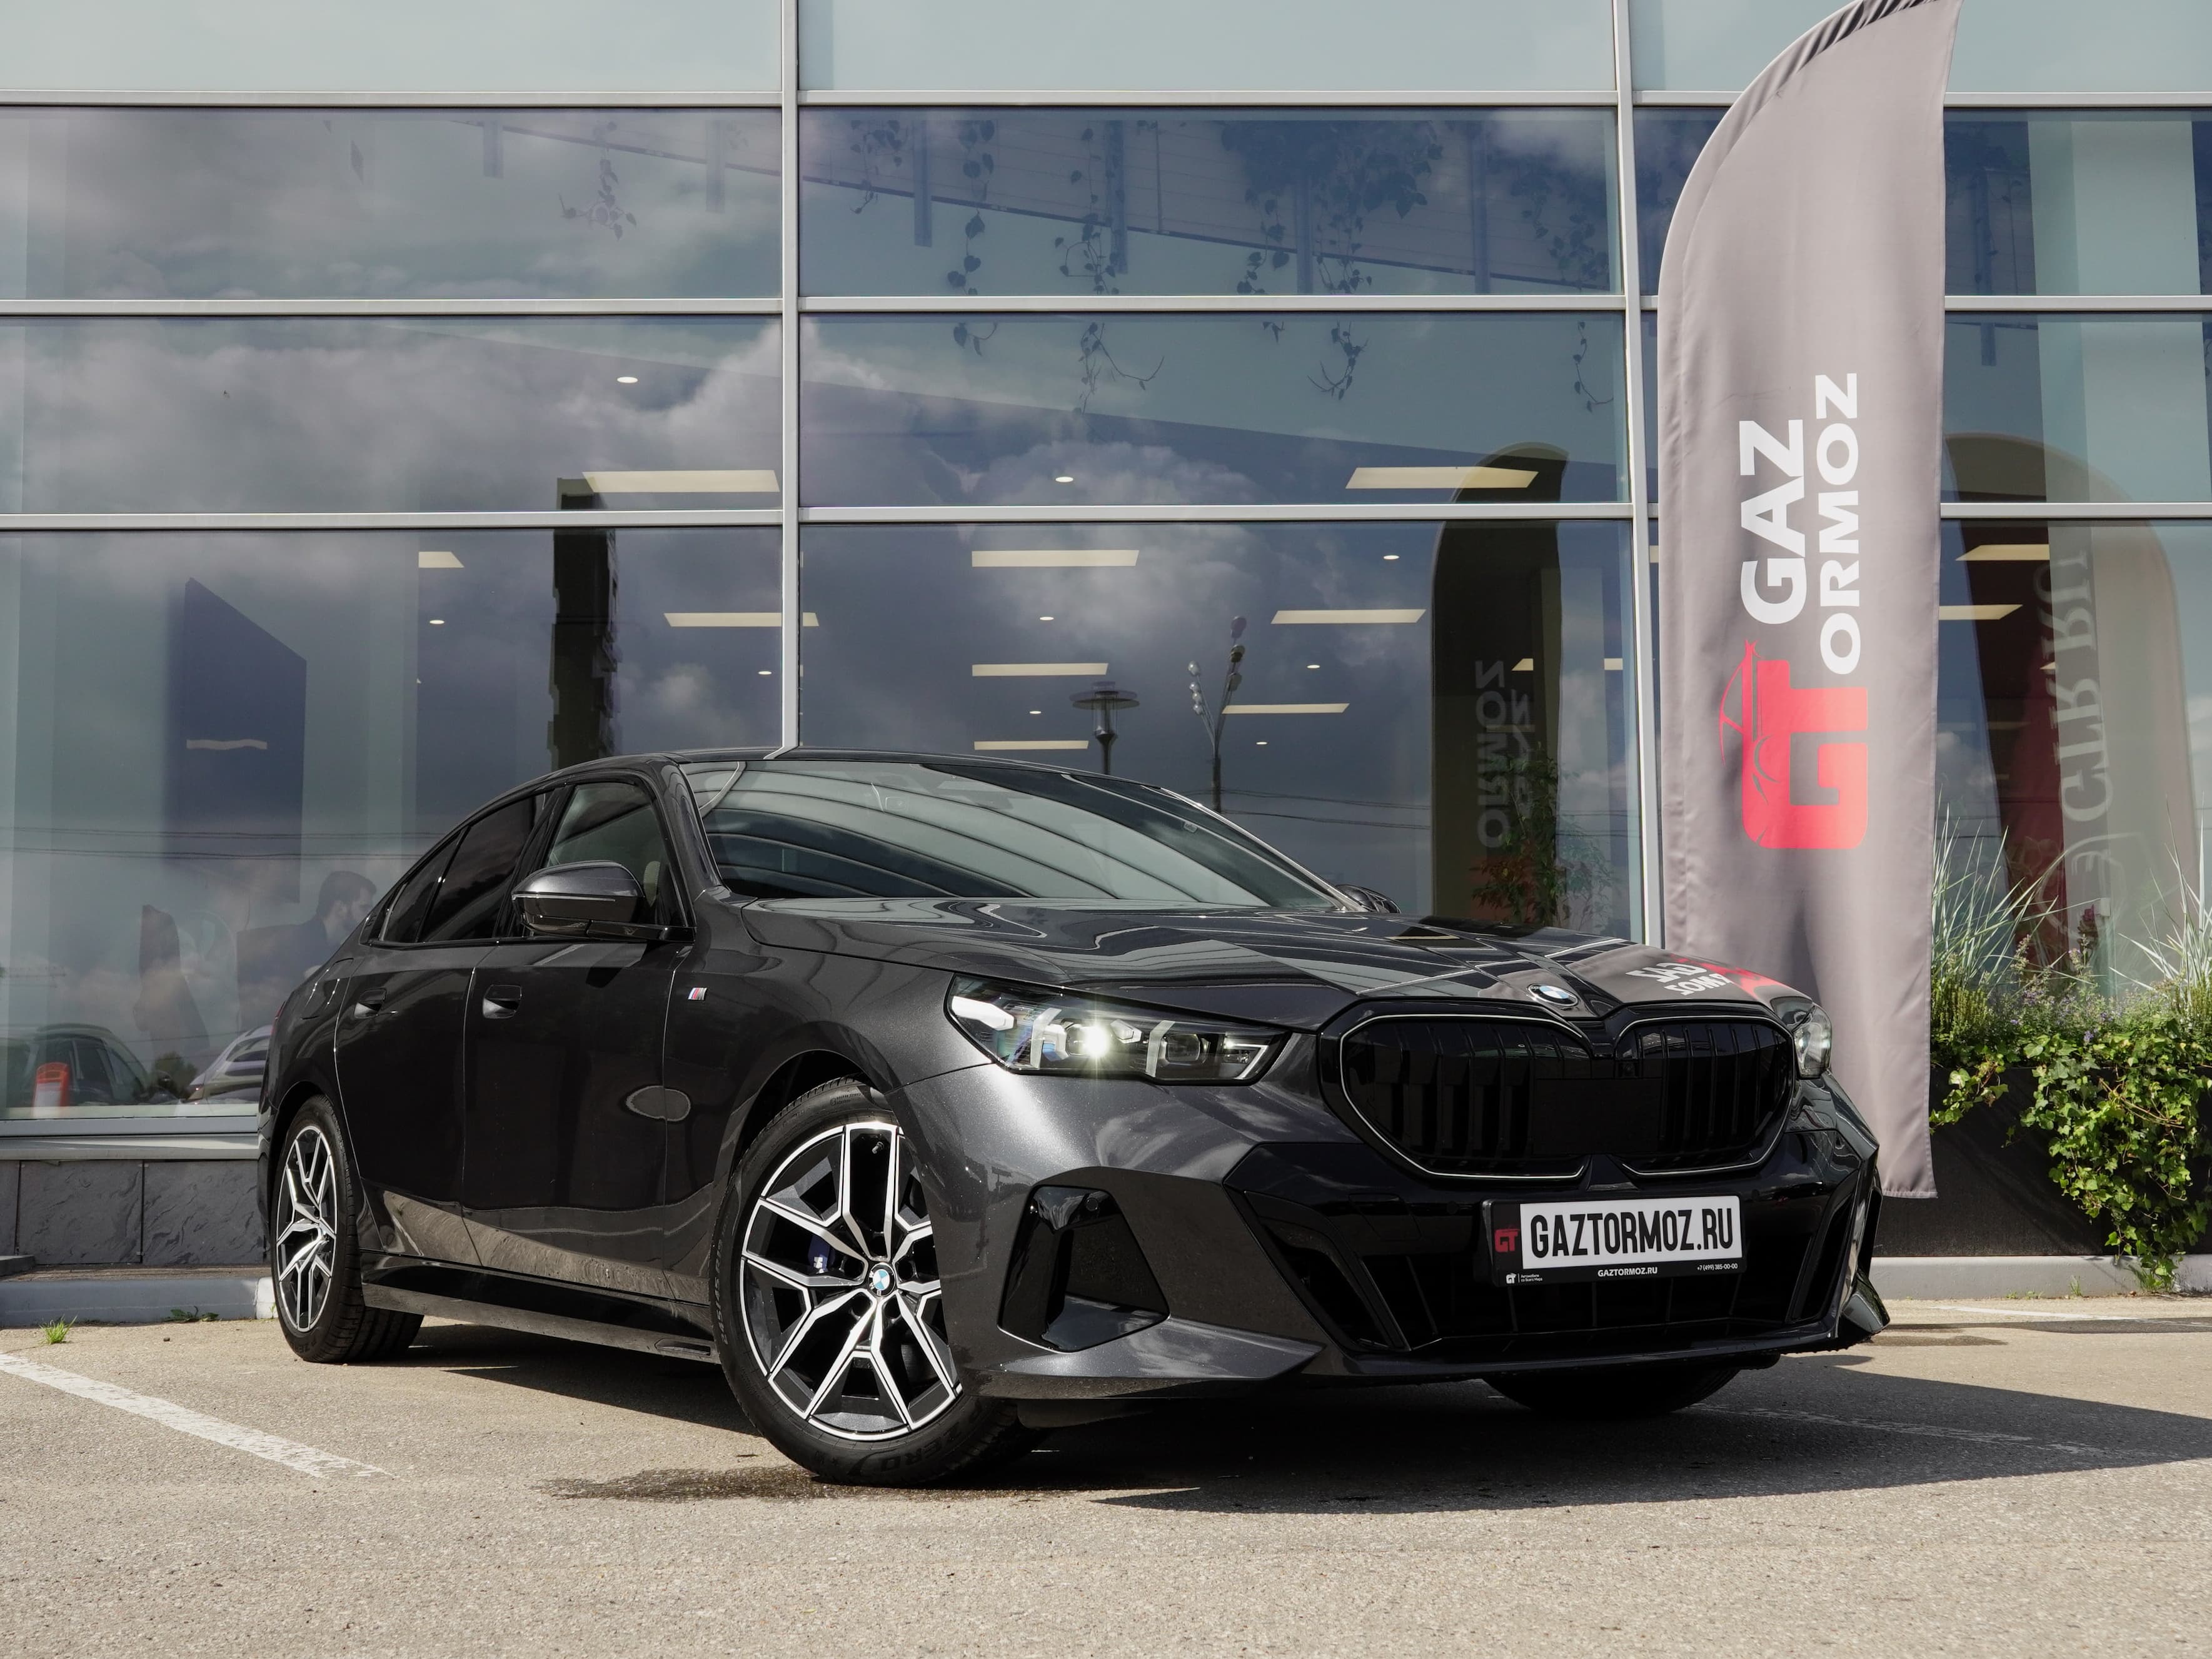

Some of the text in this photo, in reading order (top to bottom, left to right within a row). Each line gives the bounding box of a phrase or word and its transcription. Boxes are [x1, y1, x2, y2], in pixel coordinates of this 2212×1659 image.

[1739, 419, 1807, 624] GAZ
[1815, 373, 1861, 675] ORMOZ
[1741, 657, 1869, 849] GT
[1495, 1225, 1521, 1251] GT
[1530, 1208, 1734, 1258] GAZTORMOZ.RU
[1597, 1266, 1658, 1277] GAZTORMOZ.RU
